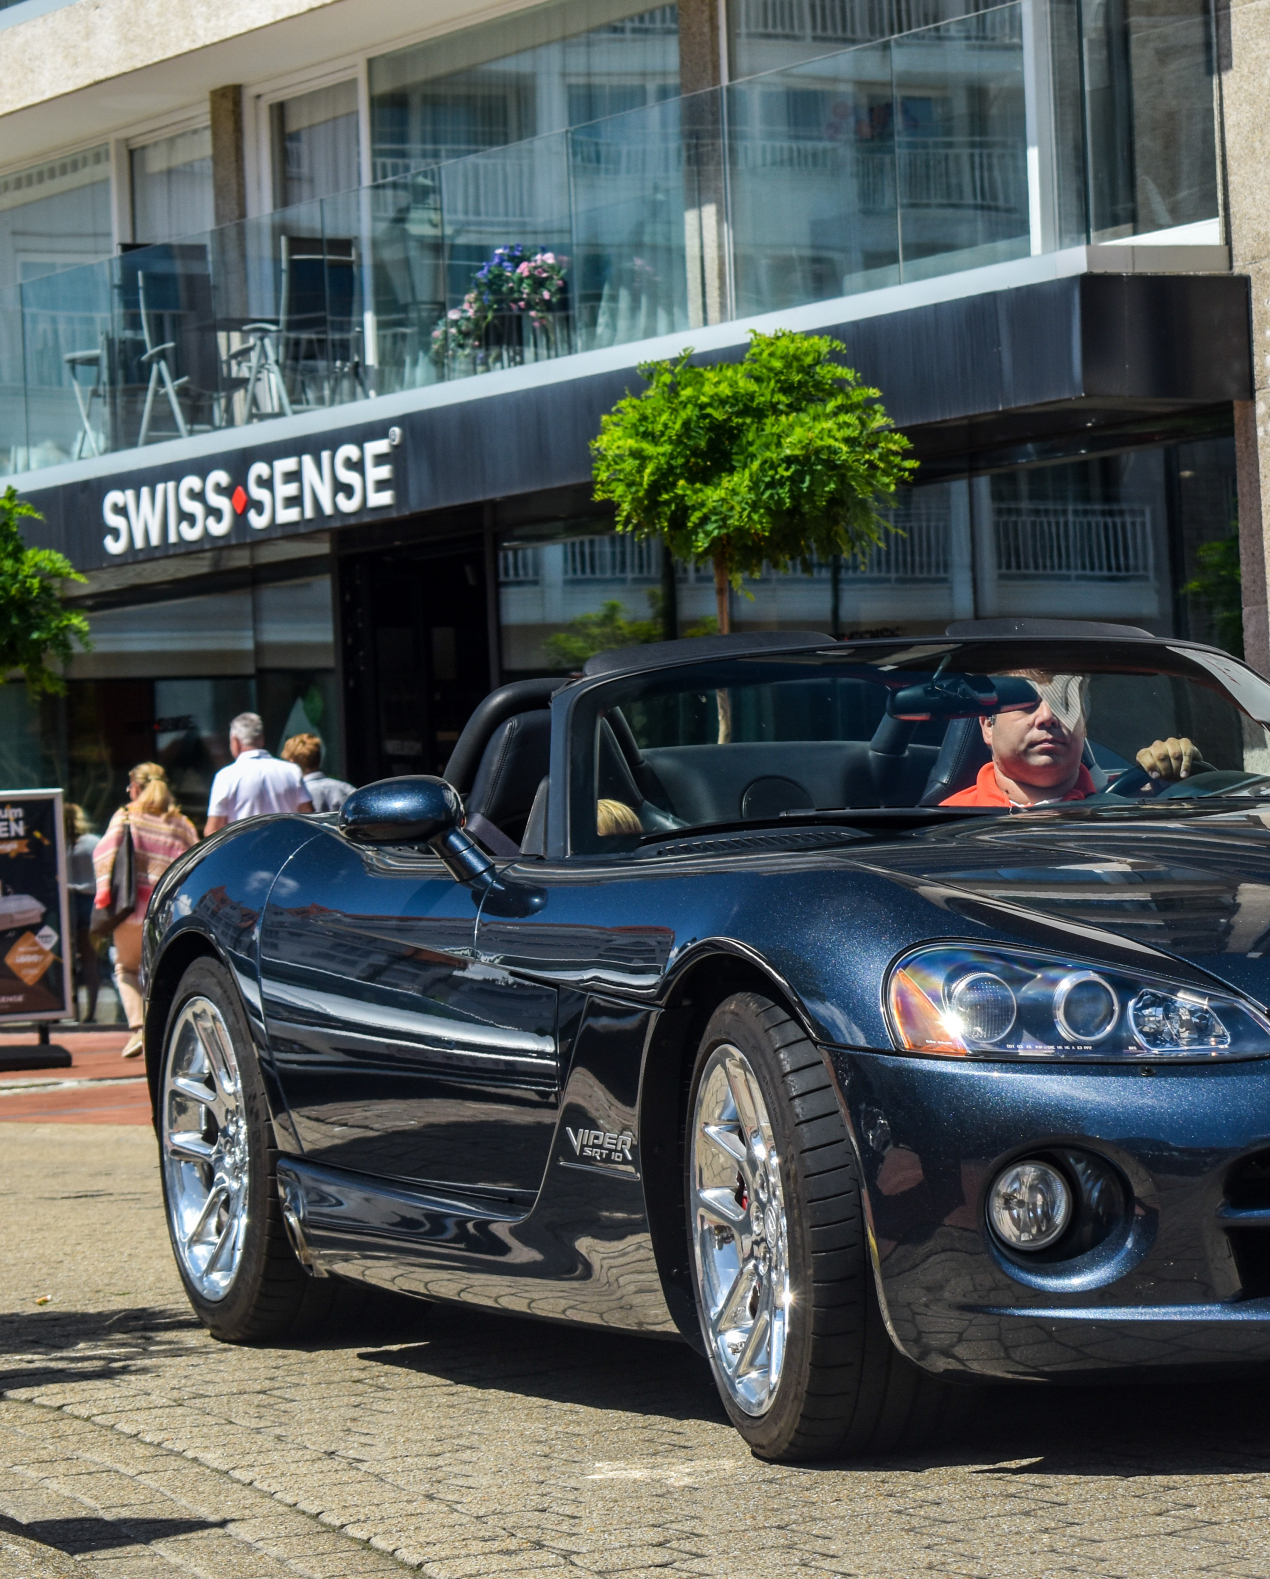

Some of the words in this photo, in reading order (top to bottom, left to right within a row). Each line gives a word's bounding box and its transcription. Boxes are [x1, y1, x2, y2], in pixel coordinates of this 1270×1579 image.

[102, 469, 234, 556] SWISS
[0, 807, 23, 820] um
[0, 820, 25, 838] EN
[565, 1126, 633, 1161] VIPER
[582, 1146, 609, 1161] SRT
[611, 1151, 623, 1162] 10
